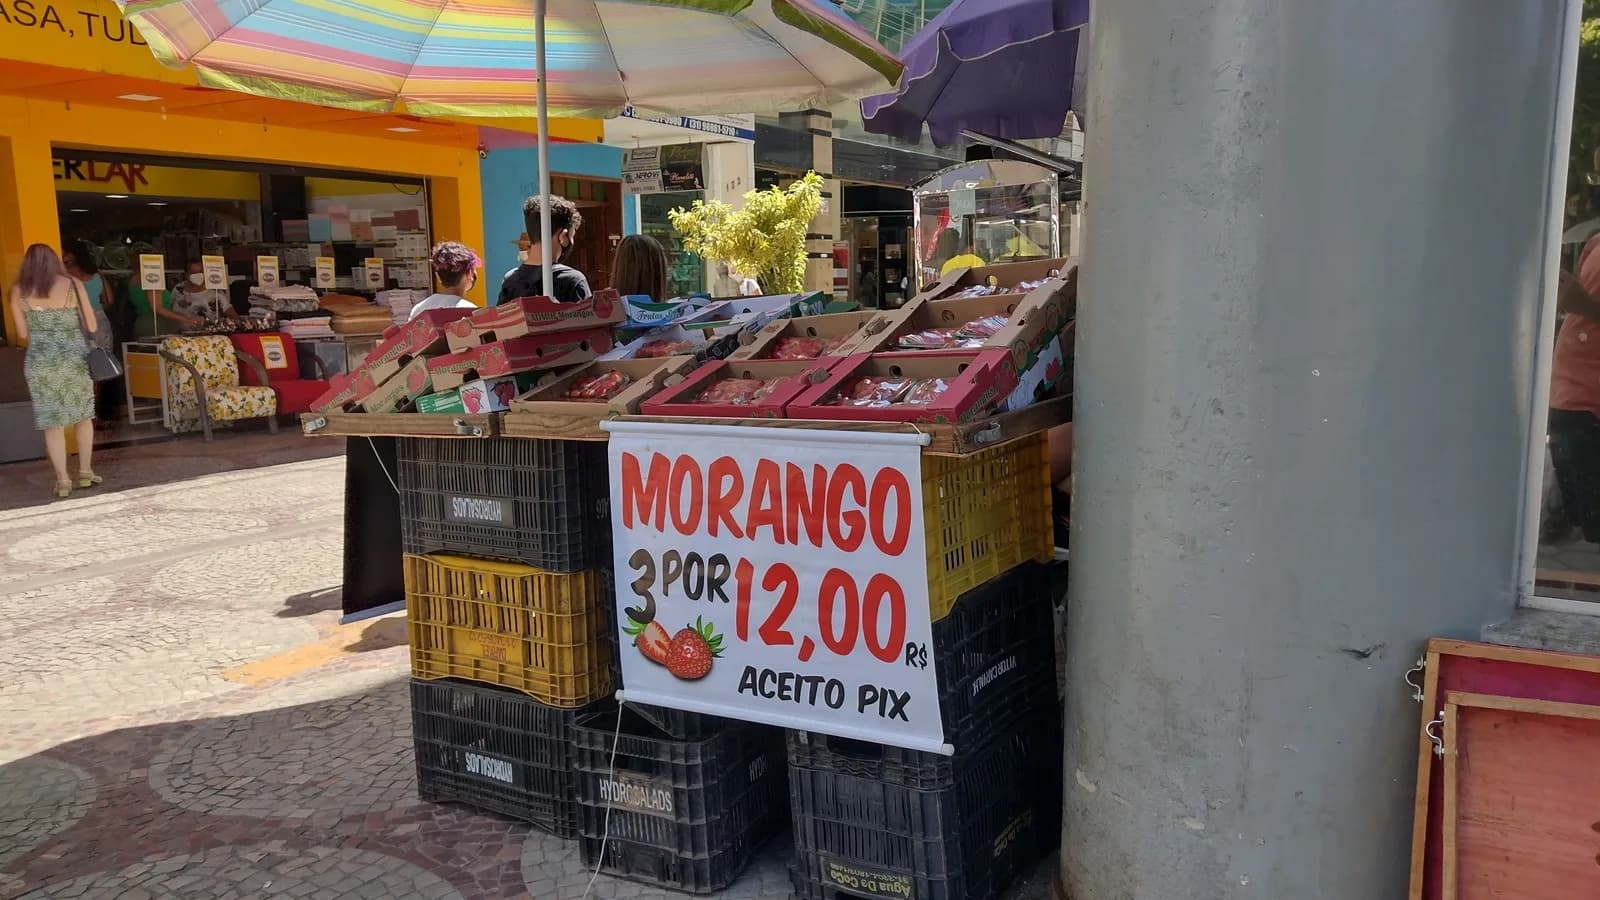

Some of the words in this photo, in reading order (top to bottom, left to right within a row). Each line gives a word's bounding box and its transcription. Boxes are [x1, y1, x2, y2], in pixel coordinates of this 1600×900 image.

[621, 451, 912, 557] MORANGO
[624, 548, 657, 625] 3
[662, 549, 732, 604] POR
[735, 556, 907, 664] 12,00
[905, 642, 928, 671] R$
[737, 665, 846, 710] ACEITO
[857, 683, 912, 722] PIX
[599, 778, 673, 813] HYDROSALADS
[880, 881, 912, 899] Agua
